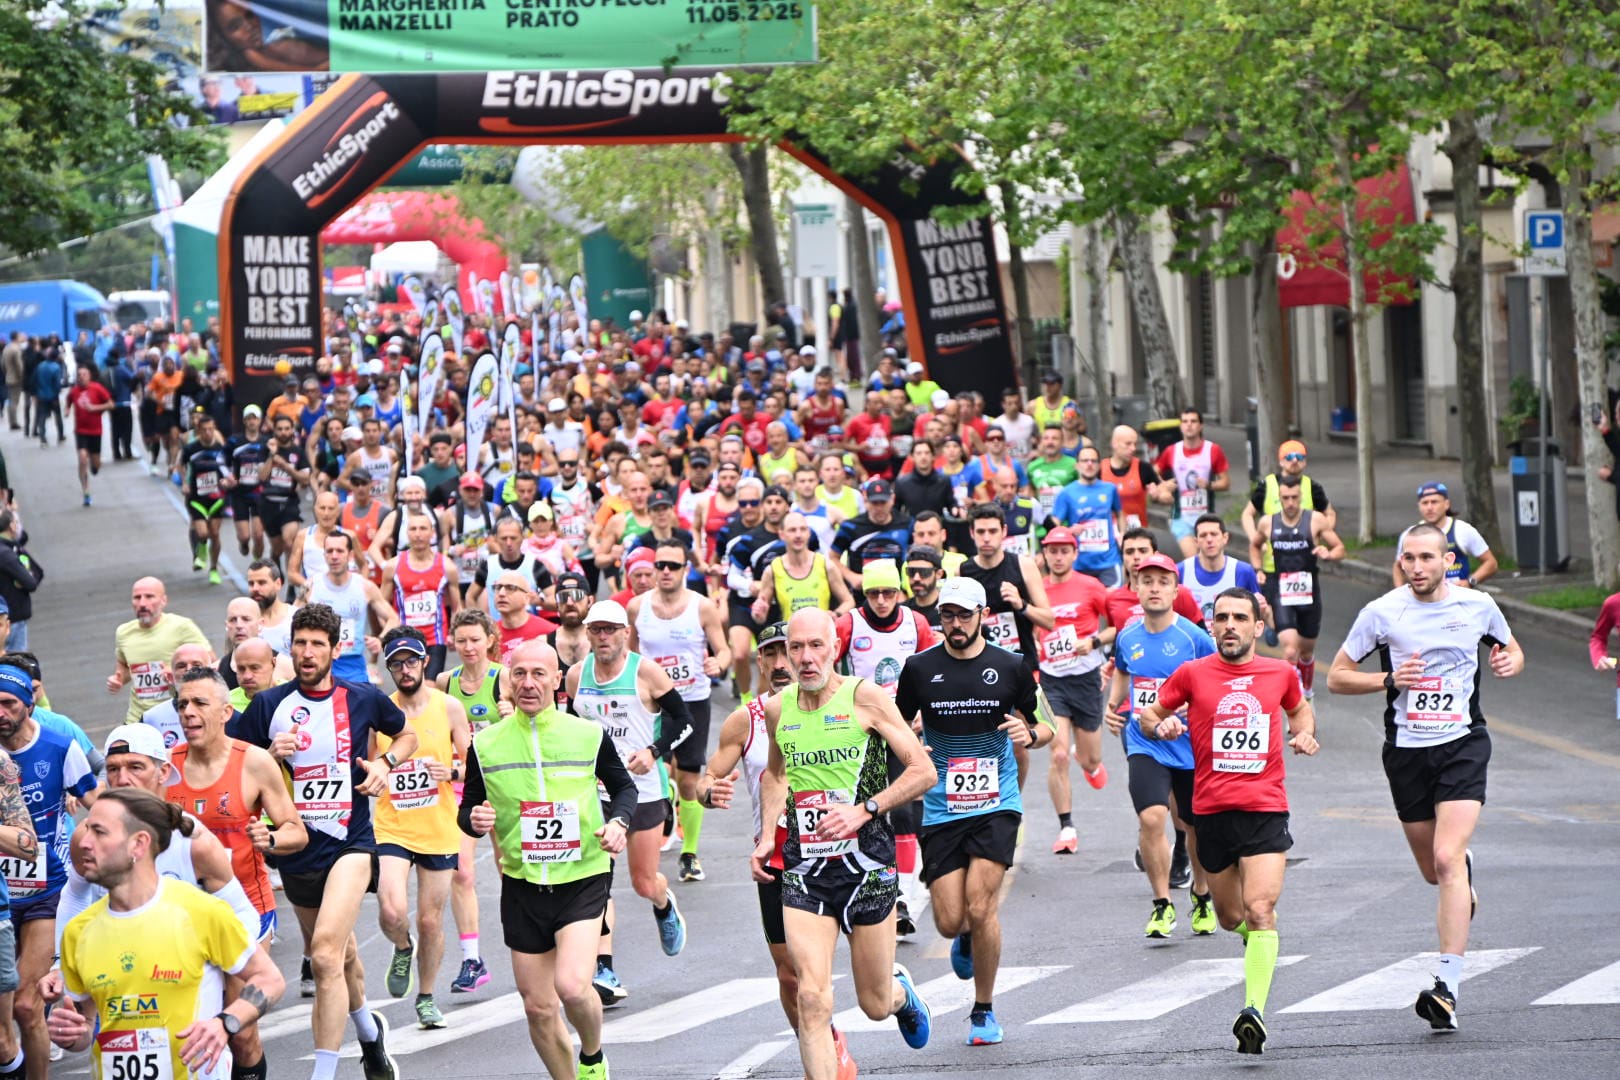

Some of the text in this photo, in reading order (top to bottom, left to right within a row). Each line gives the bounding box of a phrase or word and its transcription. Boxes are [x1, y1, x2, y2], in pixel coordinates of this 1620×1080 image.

[340, 13, 452, 31] MANZELLI
[506, 10, 579, 28] PRATO
[686, 3, 803, 23] 11.05.2025
[482, 70, 733, 116] EthicSport
[292, 101, 400, 200] EthicSport
[915, 217, 982, 246] MAKE
[1536, 218, 1556, 244] P
[243, 235, 310, 264] MAKE
[920, 241, 988, 275] YOUR
[244, 267, 310, 295] YOUR
[929, 270, 989, 305] BEST
[248, 297, 309, 325] BEST
[244, 326, 313, 339] PERFORMANCE
[935, 326, 1001, 346] EthicSport
[1273, 541, 1309, 550] ATOMICA
[1286, 582, 1307, 592] 705
[409, 601, 432, 613] 195
[1049, 638, 1073, 656] 546
[137, 673, 161, 687] 706
[930, 698, 1000, 709] sempredicorsa
[1415, 692, 1454, 711] 832
[1412, 723, 1440, 731] Alisped
[1221, 730, 1260, 750] 696
[792, 746, 860, 767] FIORINO
[302, 780, 344, 800] 677
[396, 772, 429, 791] 852
[954, 774, 989, 792] 932
[535, 819, 563, 840] 52
[527, 853, 557, 861] Alisped
[806, 846, 833, 854] Alisped
[0, 859, 37, 879] 412
[107, 998, 159, 1013] SEM
[112, 1054, 159, 1080] 505
